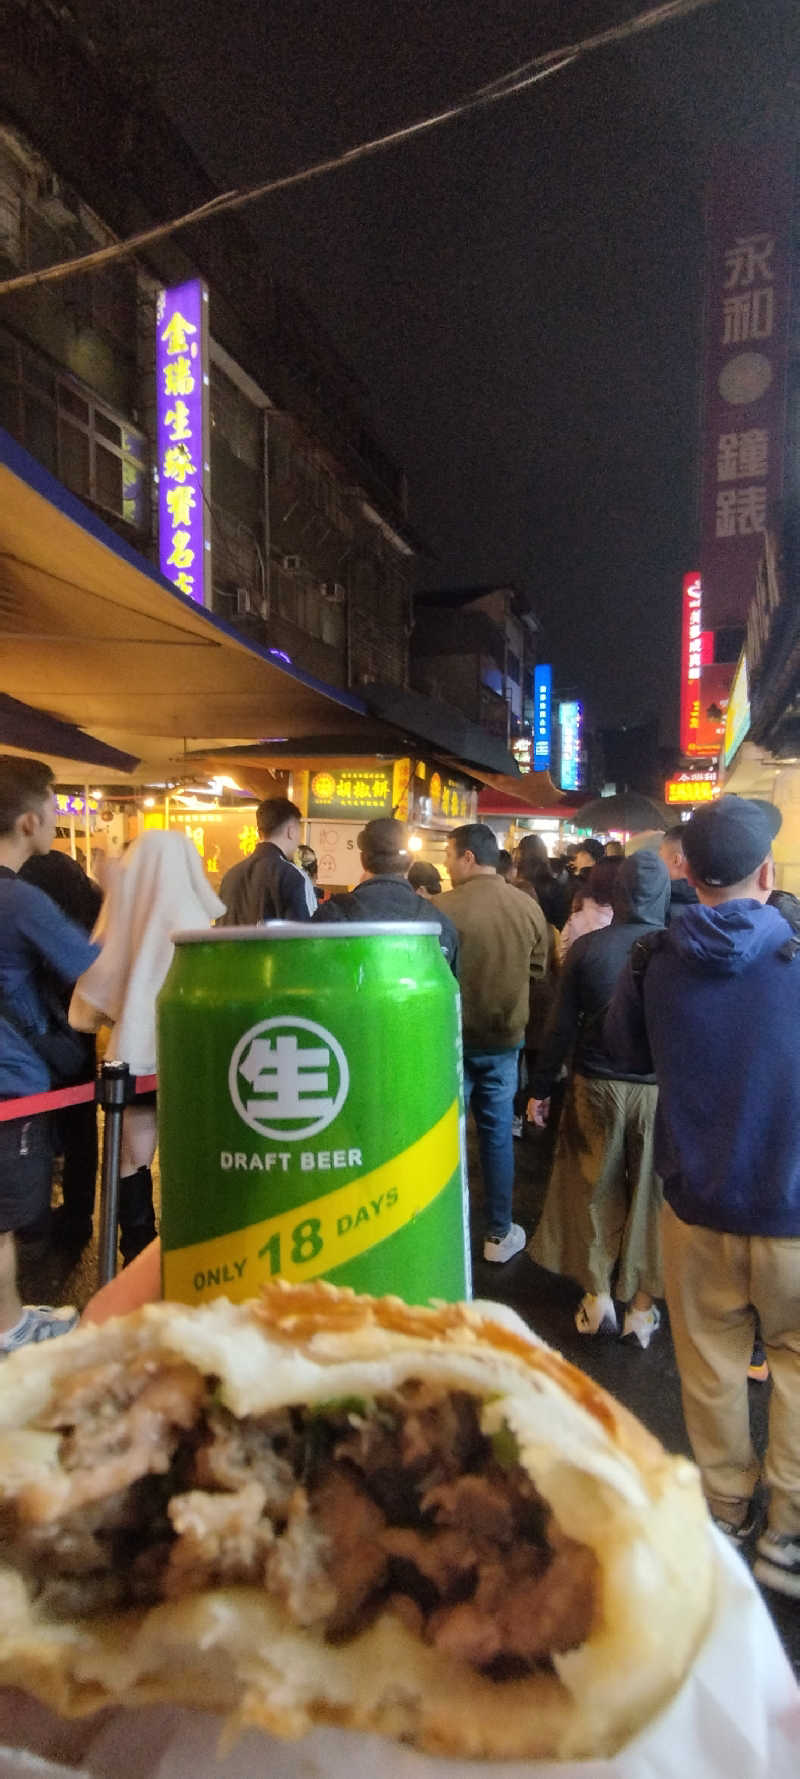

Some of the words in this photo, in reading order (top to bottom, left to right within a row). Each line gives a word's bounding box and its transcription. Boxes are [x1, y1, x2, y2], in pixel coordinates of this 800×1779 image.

[722, 232, 777, 345] 永和
[236, 1033, 337, 1121] 生
[220, 1151, 292, 1171] DRAFT
[300, 1148, 363, 1171] BEER
[193, 1259, 249, 1292] ONLY
[257, 1217, 324, 1277] 18
[336, 1186, 399, 1237] DAYS
